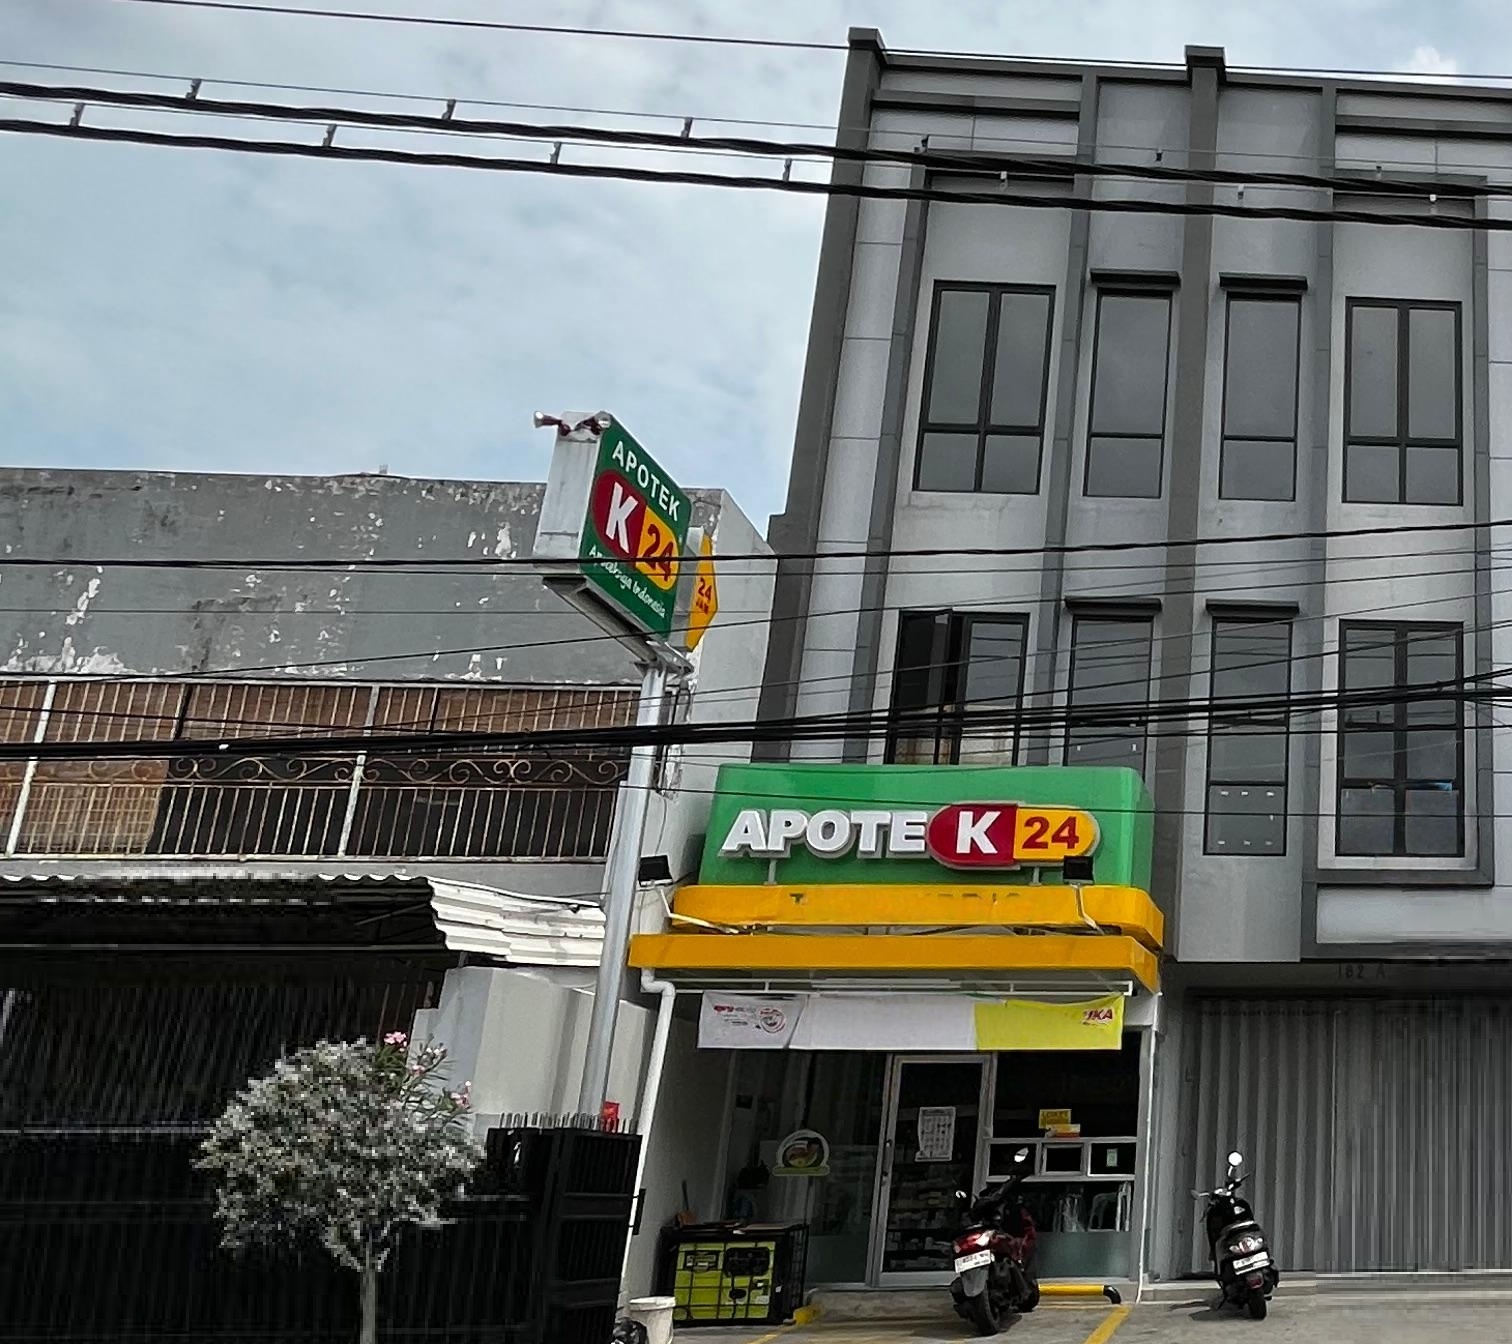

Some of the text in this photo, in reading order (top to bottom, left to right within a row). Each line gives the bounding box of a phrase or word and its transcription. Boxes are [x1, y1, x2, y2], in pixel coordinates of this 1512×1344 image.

[612, 440, 680, 521] APOTEK
[606, 482, 674, 582] K 24
[698, 577, 712, 601] 24
[1021, 816, 1080, 849] 24
